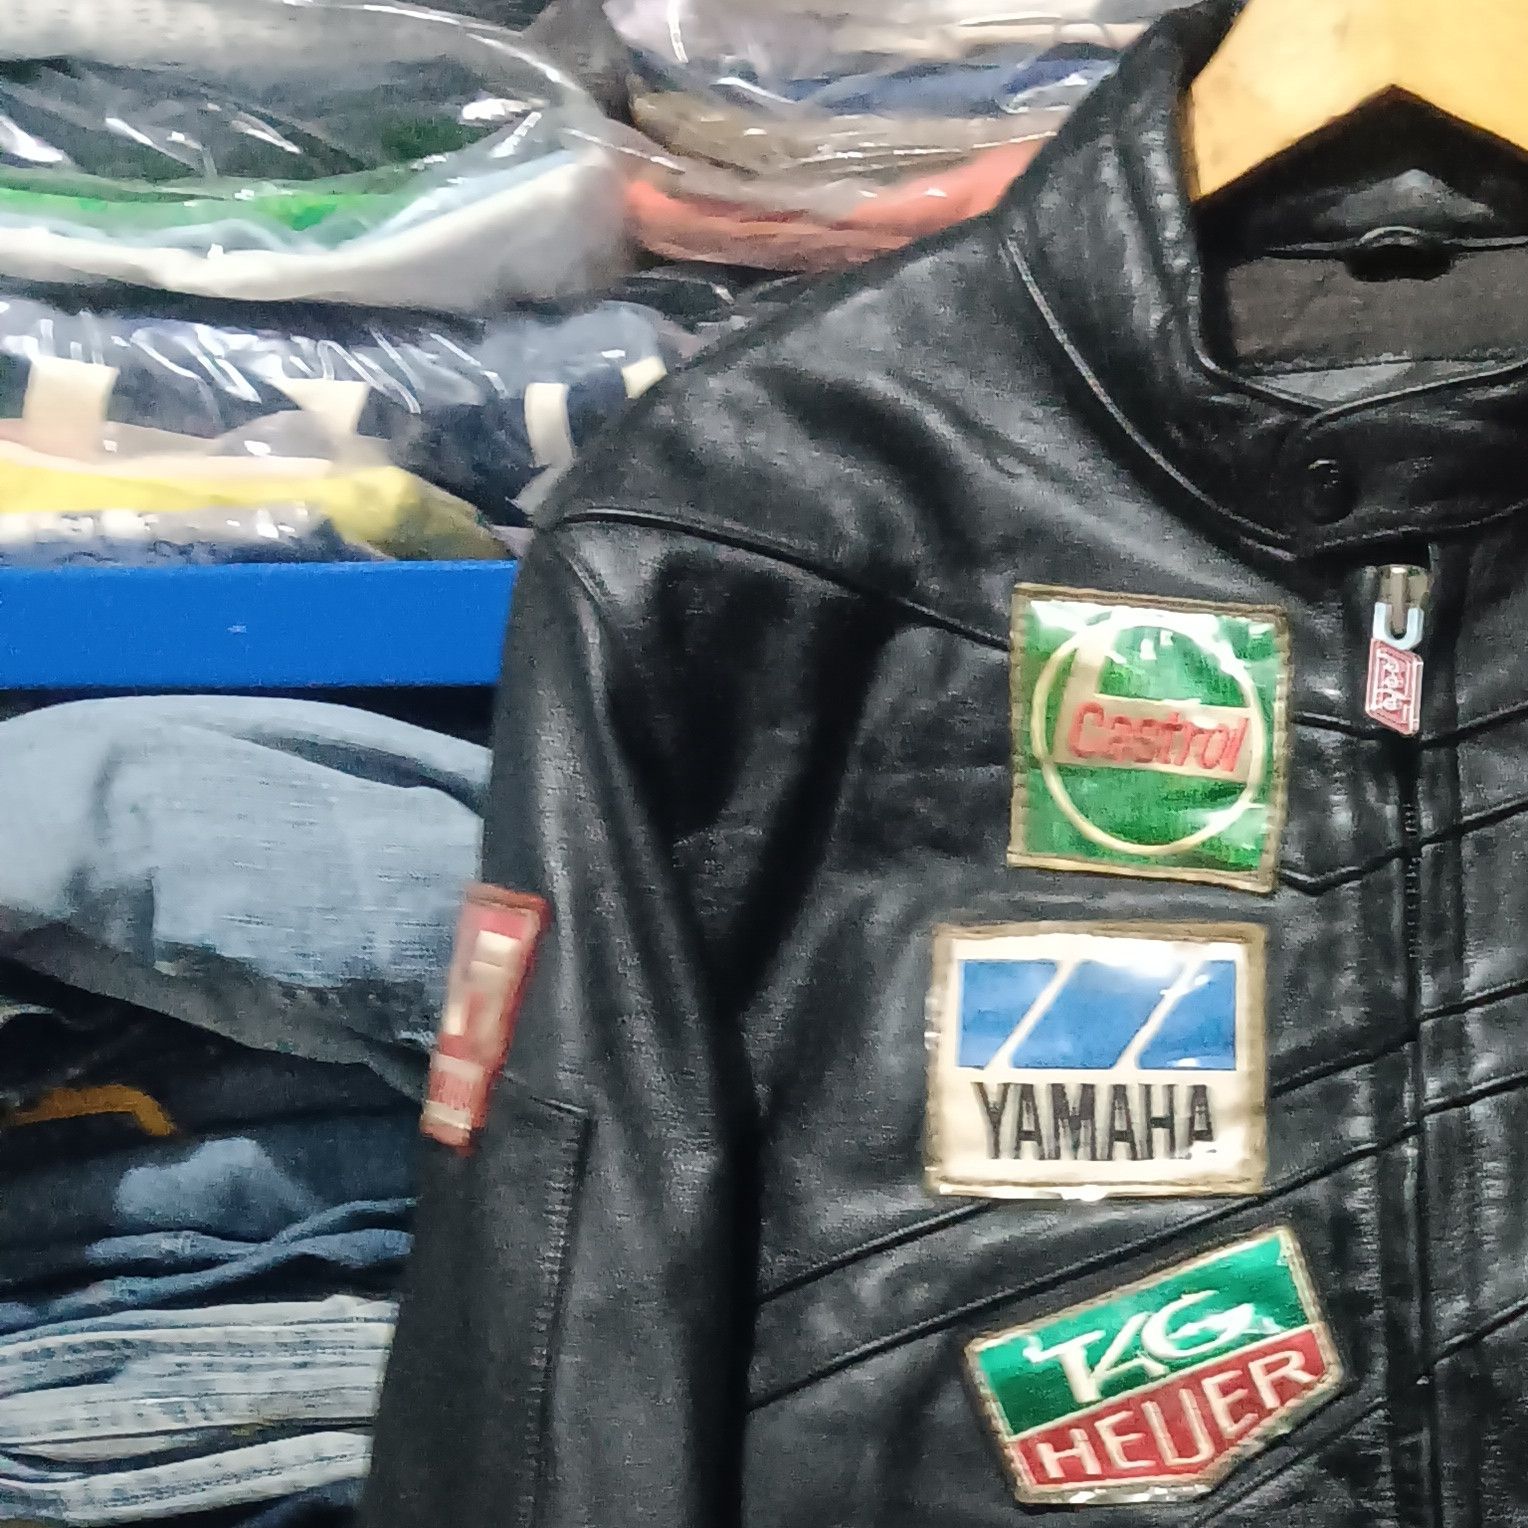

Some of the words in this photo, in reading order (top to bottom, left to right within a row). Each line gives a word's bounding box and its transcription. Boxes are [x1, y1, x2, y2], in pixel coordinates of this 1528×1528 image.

[1068, 702, 1249, 772] Castrol
[972, 1079, 1215, 1161] YAMAHA
[1022, 1288, 1282, 1404] TAG
[1036, 1348, 1323, 1480] HEUER
